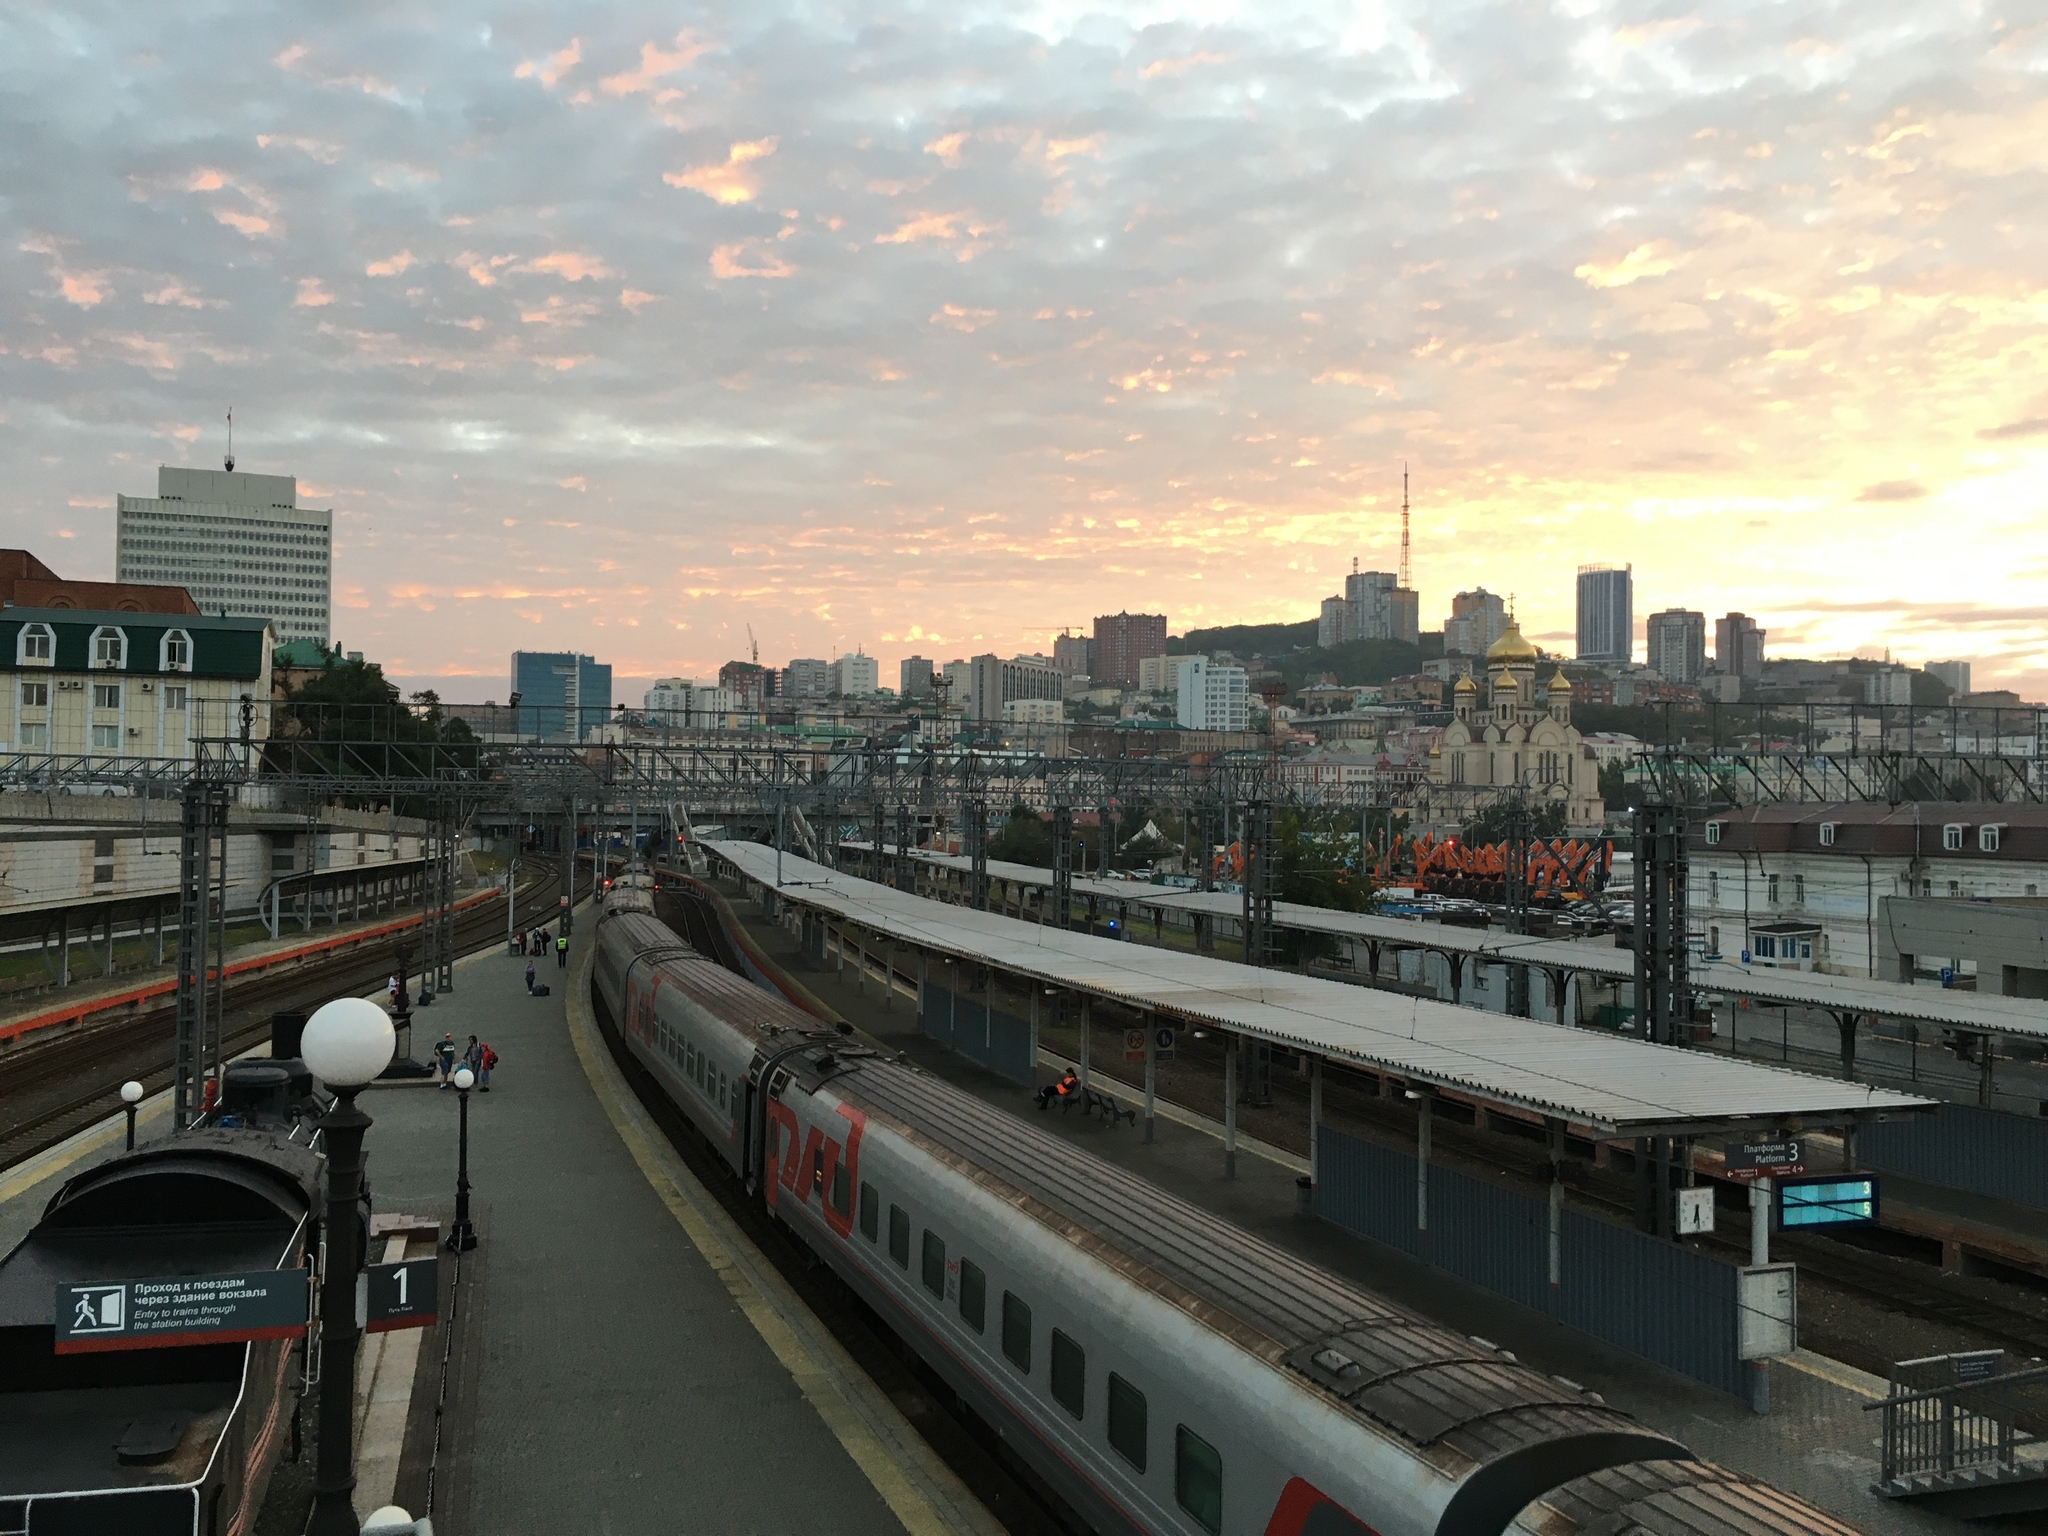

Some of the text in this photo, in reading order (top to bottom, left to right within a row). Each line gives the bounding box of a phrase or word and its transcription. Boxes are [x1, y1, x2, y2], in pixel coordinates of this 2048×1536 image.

[1743, 1142, 1799, 1162] Платформа 3
[1755, 1154, 1786, 1164] Platform
[1863, 1181, 1870, 1195] 3
[1863, 1202, 1870, 1215] 5
[134, 1278, 245, 1295] Проход к поездам
[392, 1266, 408, 1305] 1
[134, 1288, 267, 1306] через здание вокзала
[133, 1303, 237, 1320] Entry to trains through
[133, 1315, 221, 1330] the station building
